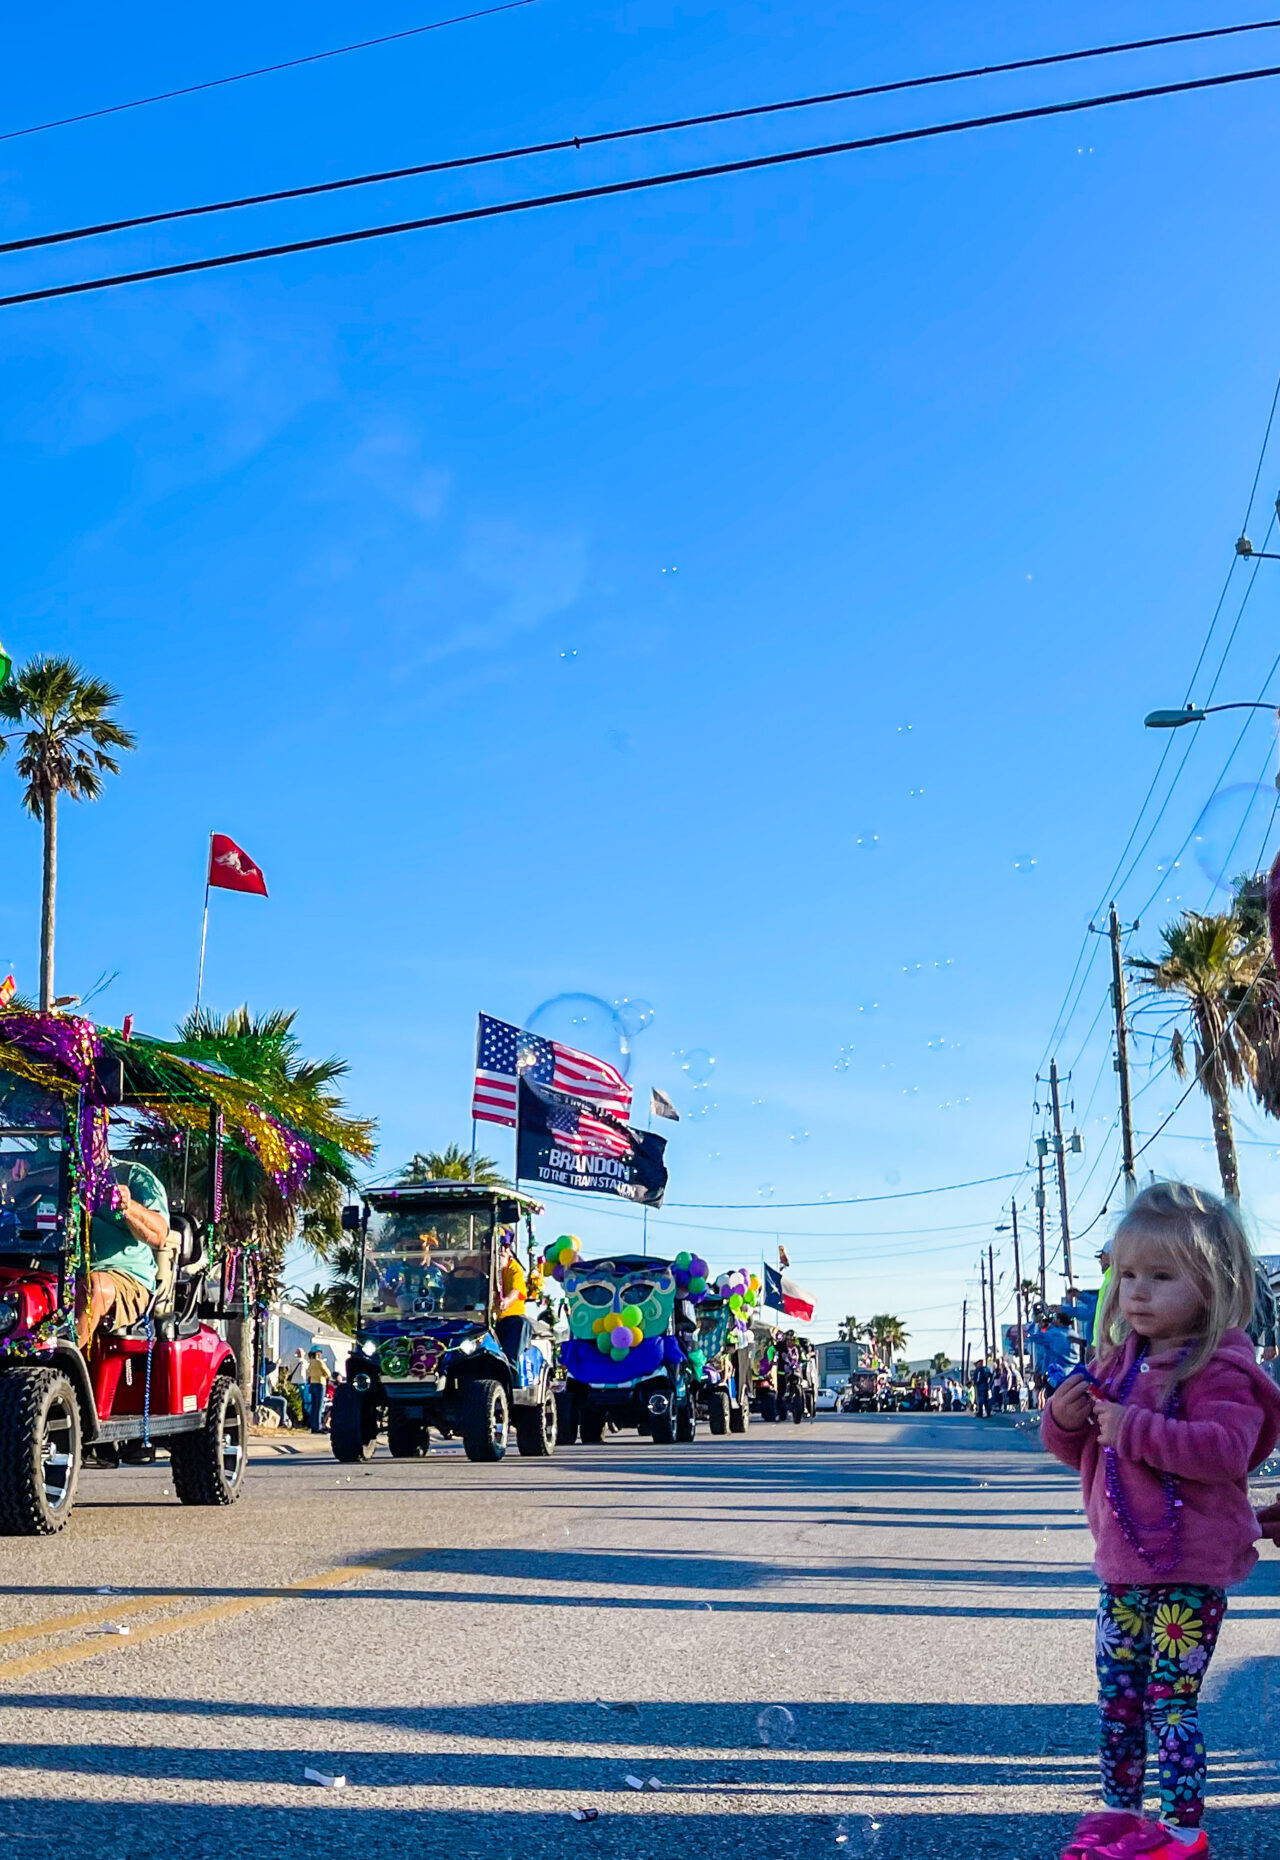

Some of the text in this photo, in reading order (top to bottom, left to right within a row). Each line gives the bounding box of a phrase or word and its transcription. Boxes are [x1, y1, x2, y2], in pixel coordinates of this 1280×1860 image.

[549, 1149, 630, 1181] BRANDON
[538, 1166, 638, 1198] TO THE TRAIN STATION
